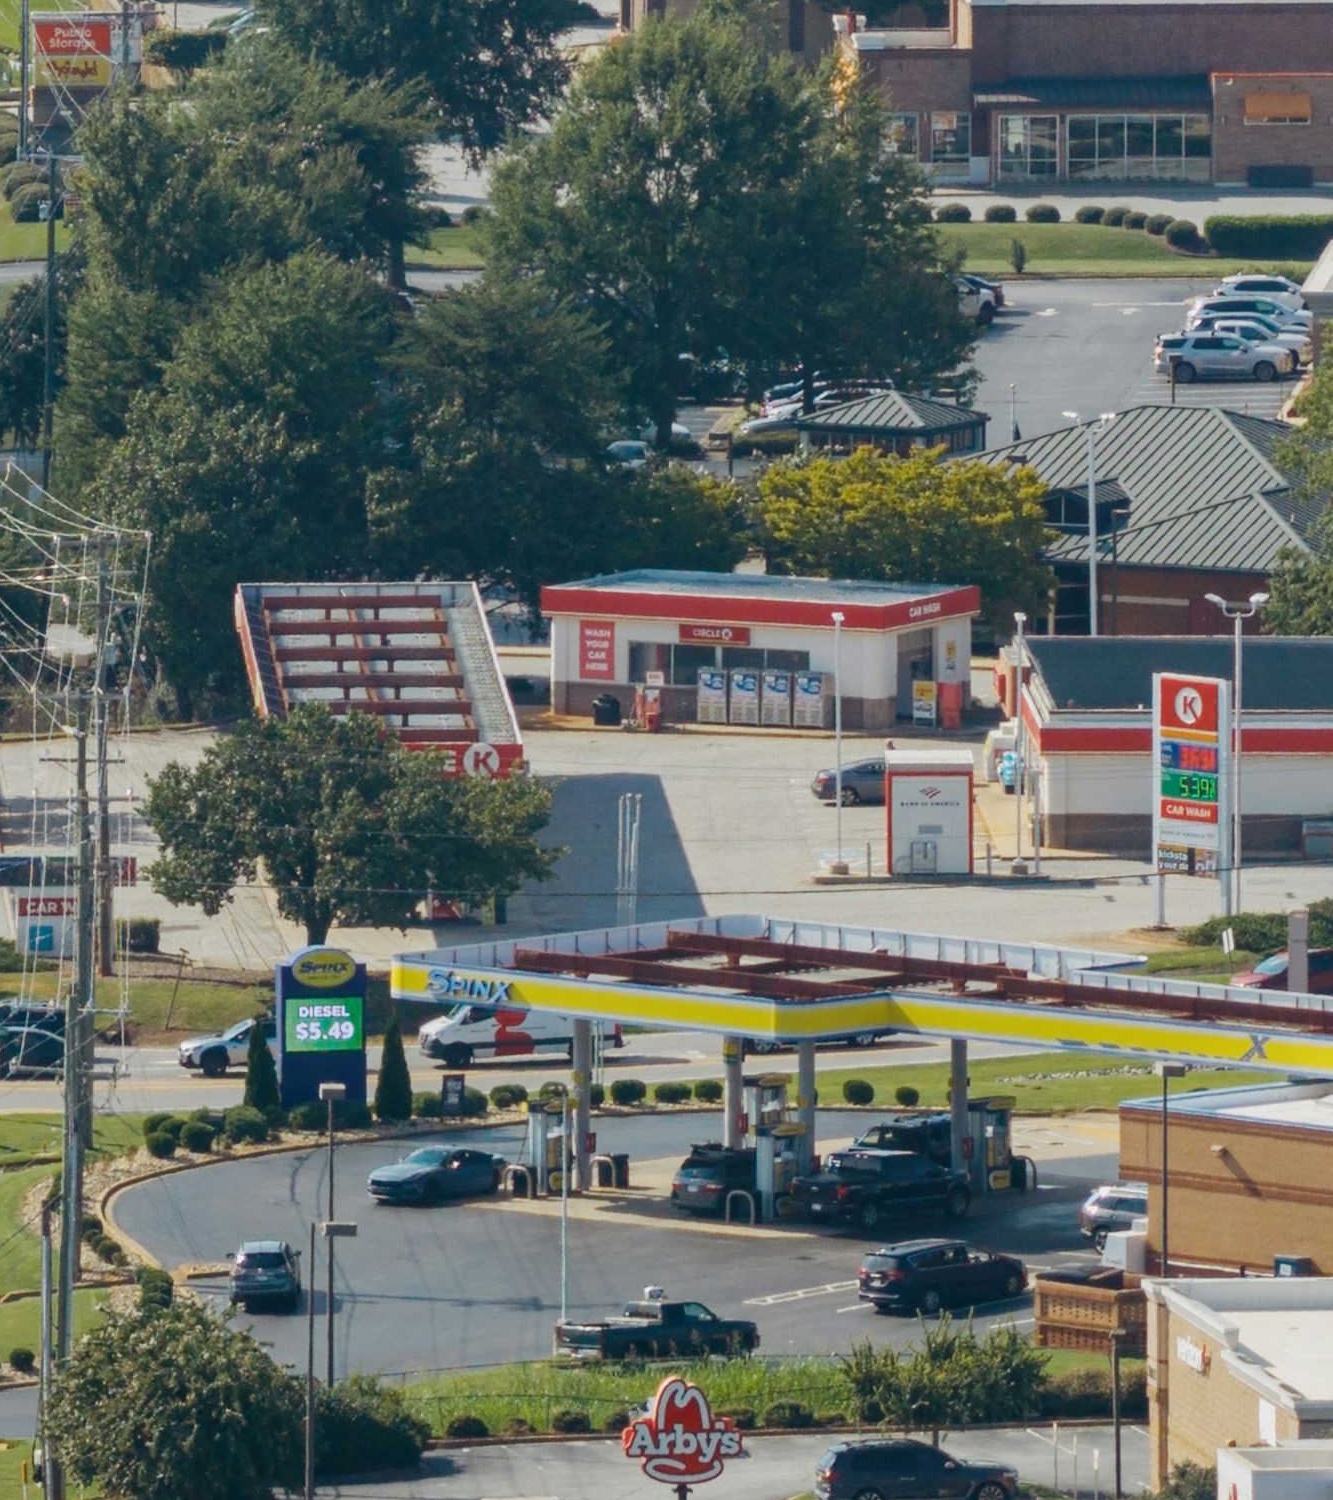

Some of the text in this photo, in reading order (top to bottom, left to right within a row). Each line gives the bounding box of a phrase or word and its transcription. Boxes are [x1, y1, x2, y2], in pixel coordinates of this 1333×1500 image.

[54, 27, 92, 37] Public
[49, 38, 96, 51] Storage
[584, 629, 611, 638] WASH
[692, 628, 721, 638] CIRCLE
[585, 641, 610, 649] YOUR
[587, 651, 607, 660] CAR
[585, 663, 609, 672] HERE
[1166, 804, 1211, 818] CAR WASH
[26, 901, 58, 914] CAR
[299, 961, 349, 974] SPINX
[426, 968, 513, 1004] SPINX
[298, 1004, 351, 1018] DIESEL
[295, 1020, 355, 1042] $5.49
[628, 1421, 740, 1463] Arby's
